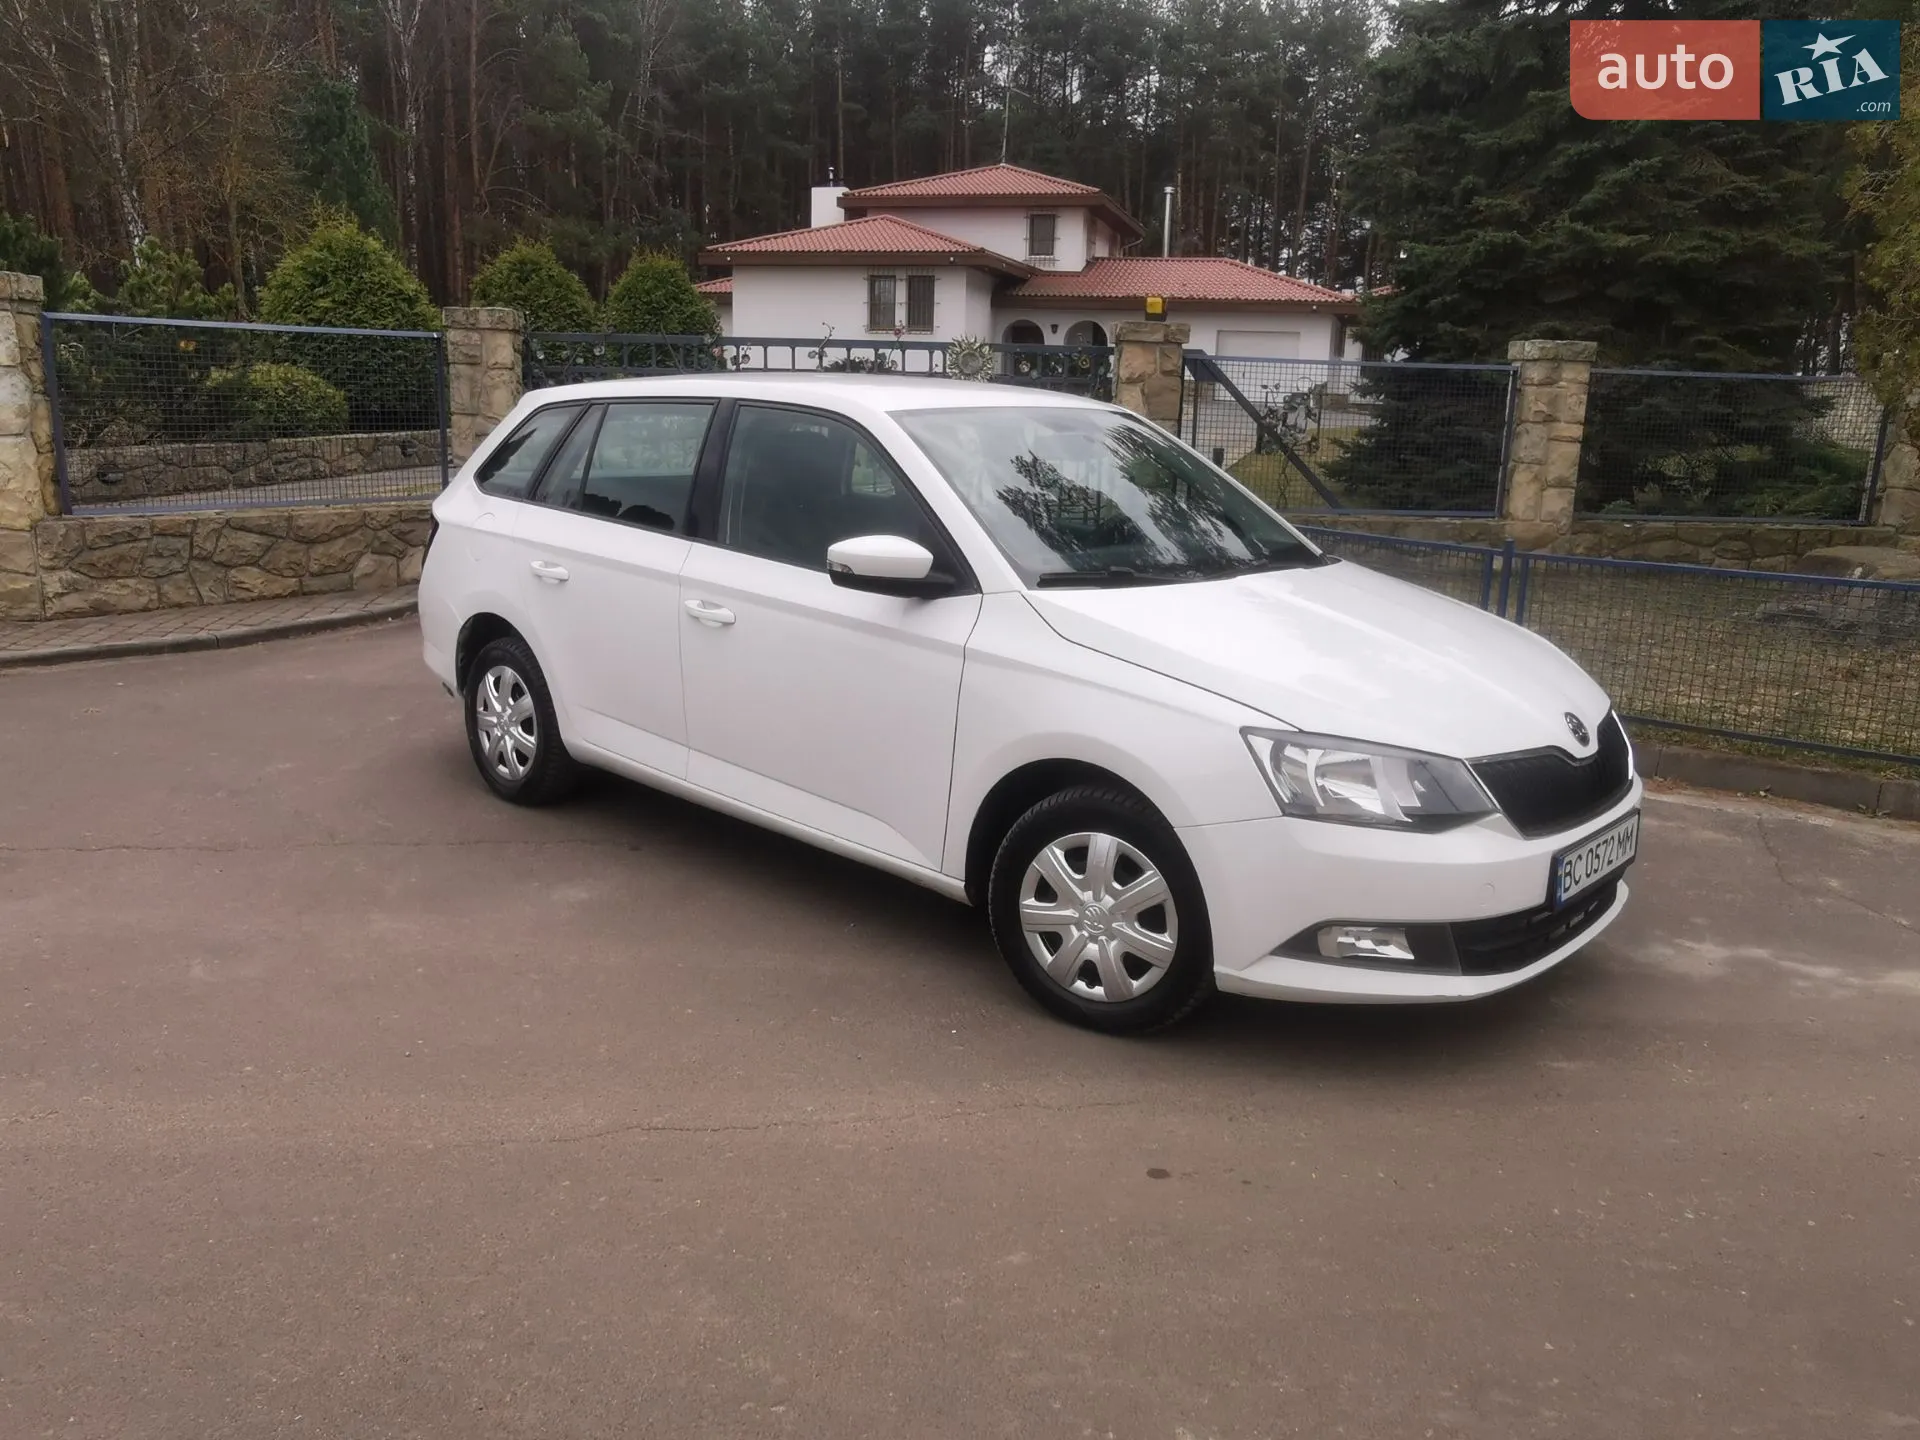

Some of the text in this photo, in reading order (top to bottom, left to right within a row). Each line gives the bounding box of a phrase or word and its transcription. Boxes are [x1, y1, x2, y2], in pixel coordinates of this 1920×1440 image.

[1563, 824, 1634, 893] BC 0572 MM
